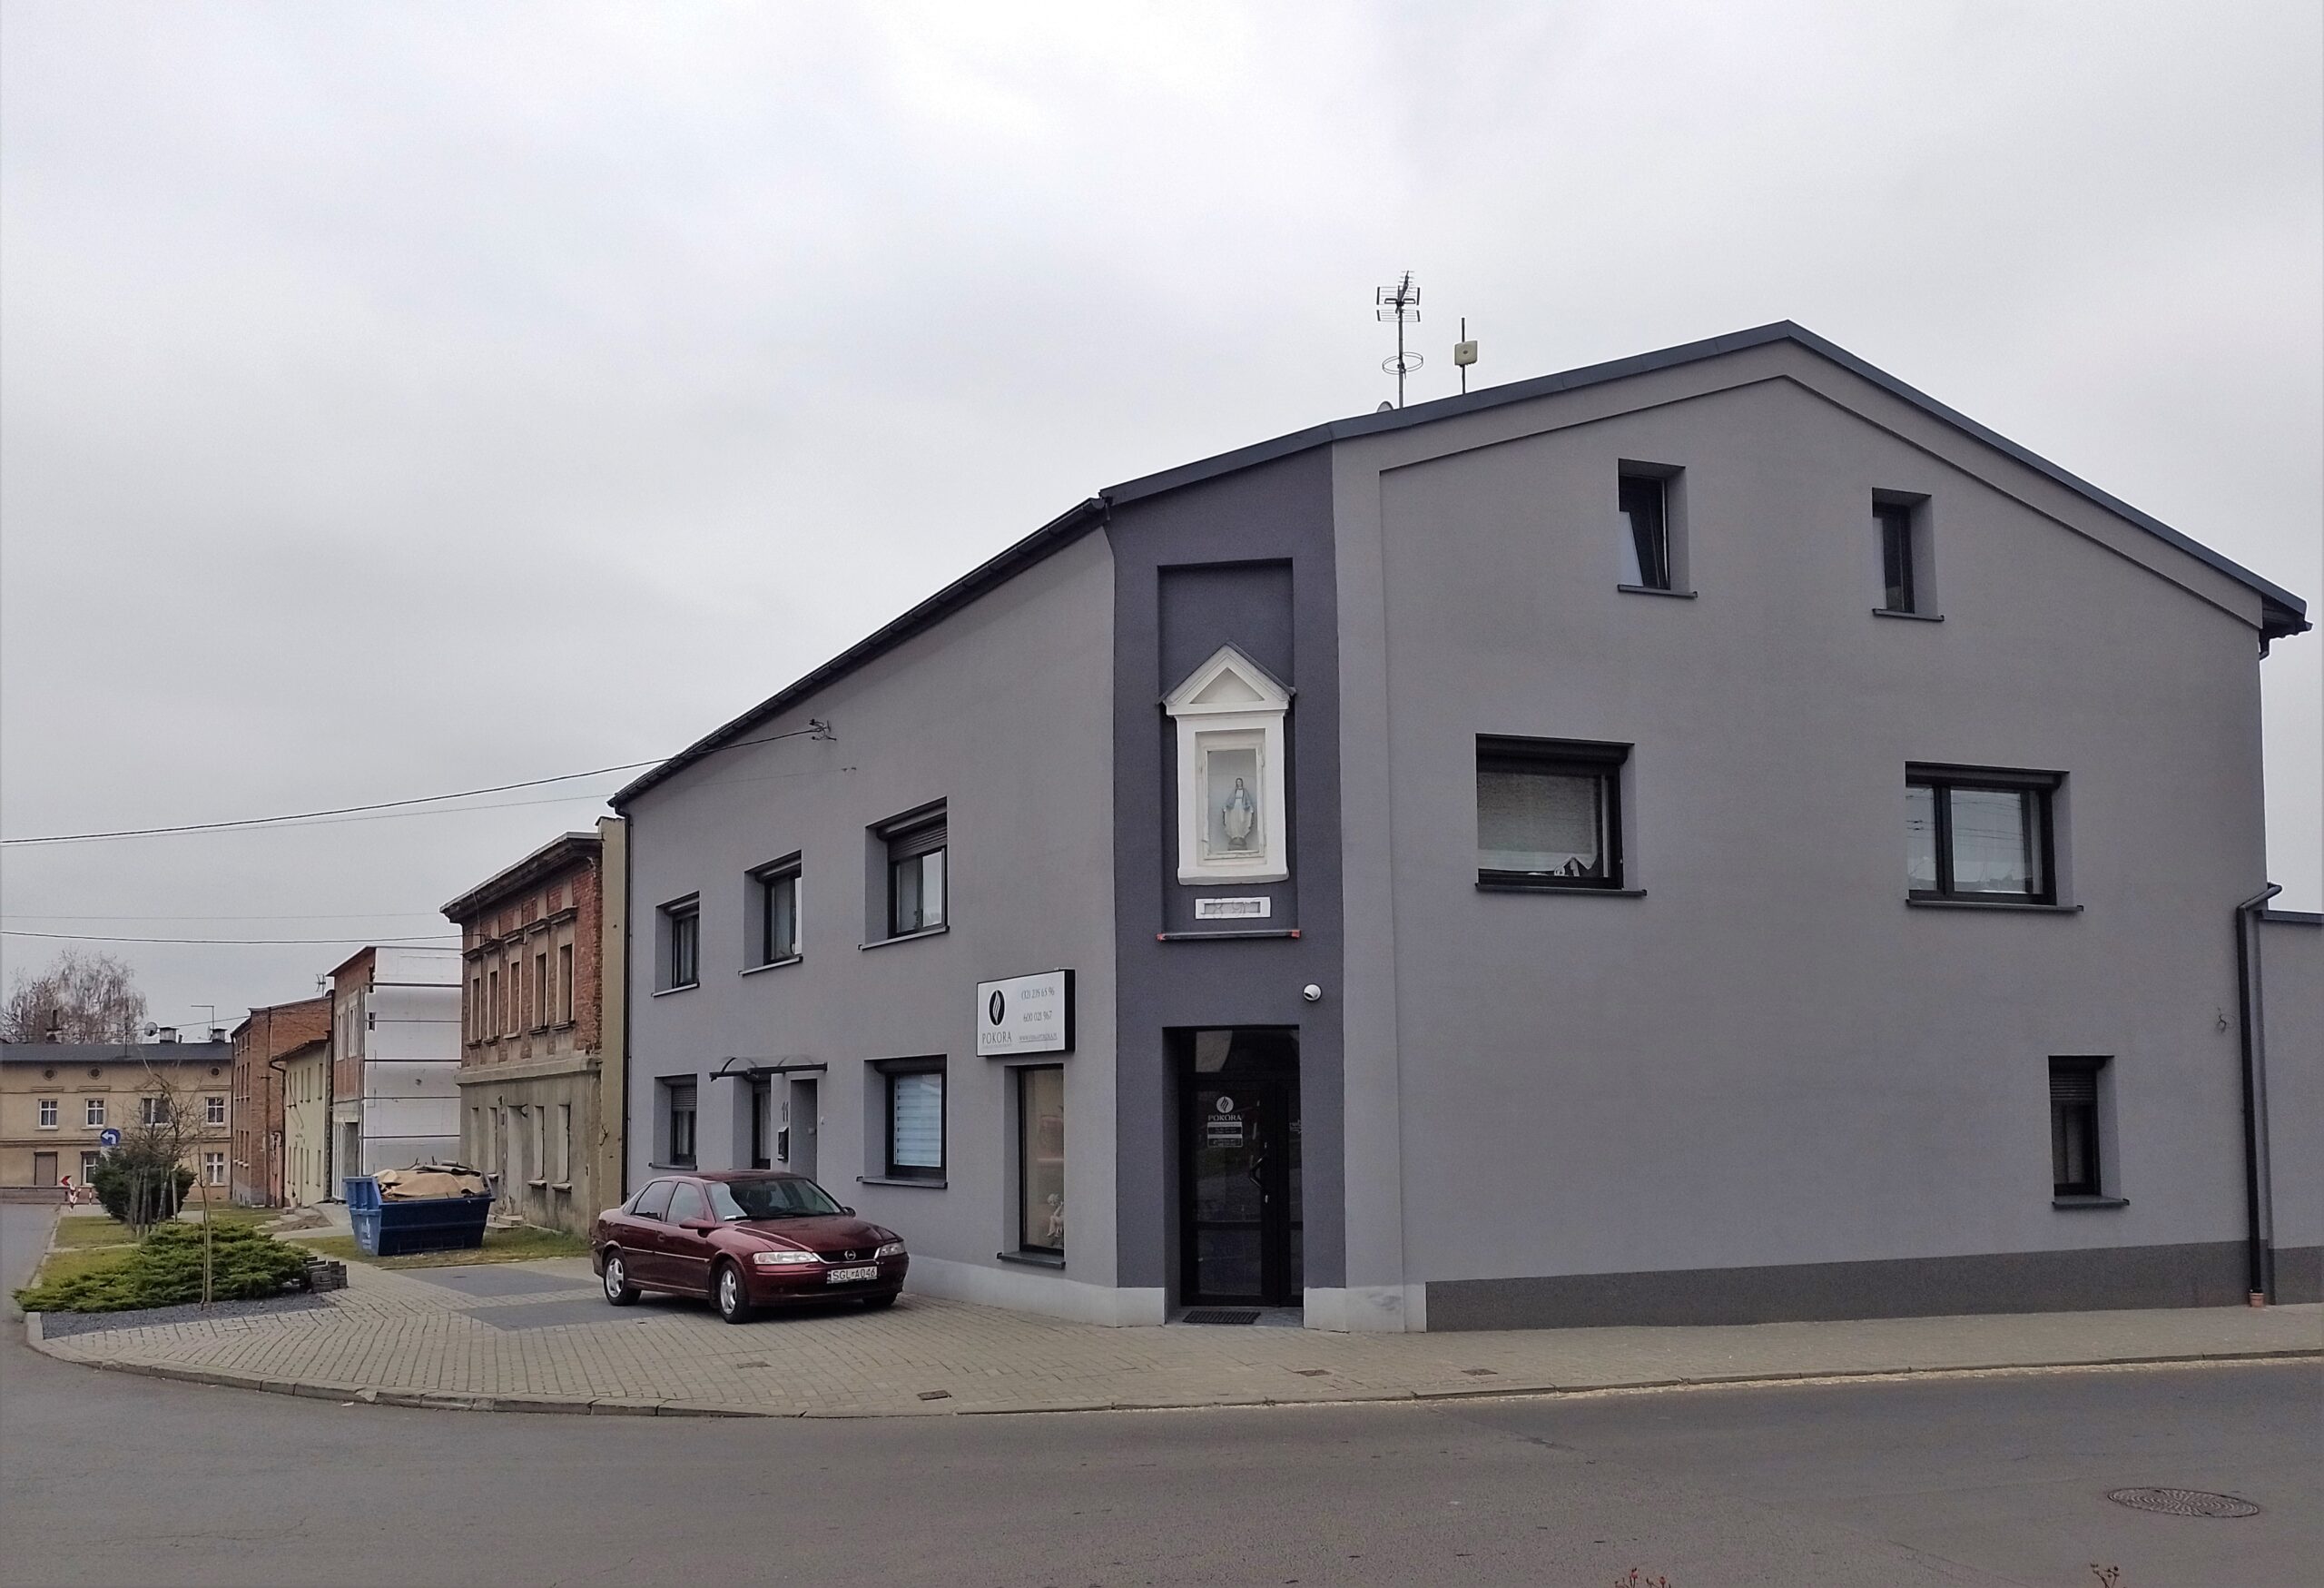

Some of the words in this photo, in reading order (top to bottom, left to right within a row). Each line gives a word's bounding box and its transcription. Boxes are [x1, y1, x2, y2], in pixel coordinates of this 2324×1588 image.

[1041, 988, 1048, 997] 65
[1049, 986, 1055, 996] 96
[1023, 1012, 1033, 1022] 600
[1043, 1011, 1053, 1020] 967
[981, 1031, 1012, 1045] POKORA
[832, 1270, 852, 1280] SGL
[855, 1267, 876, 1278] A046
